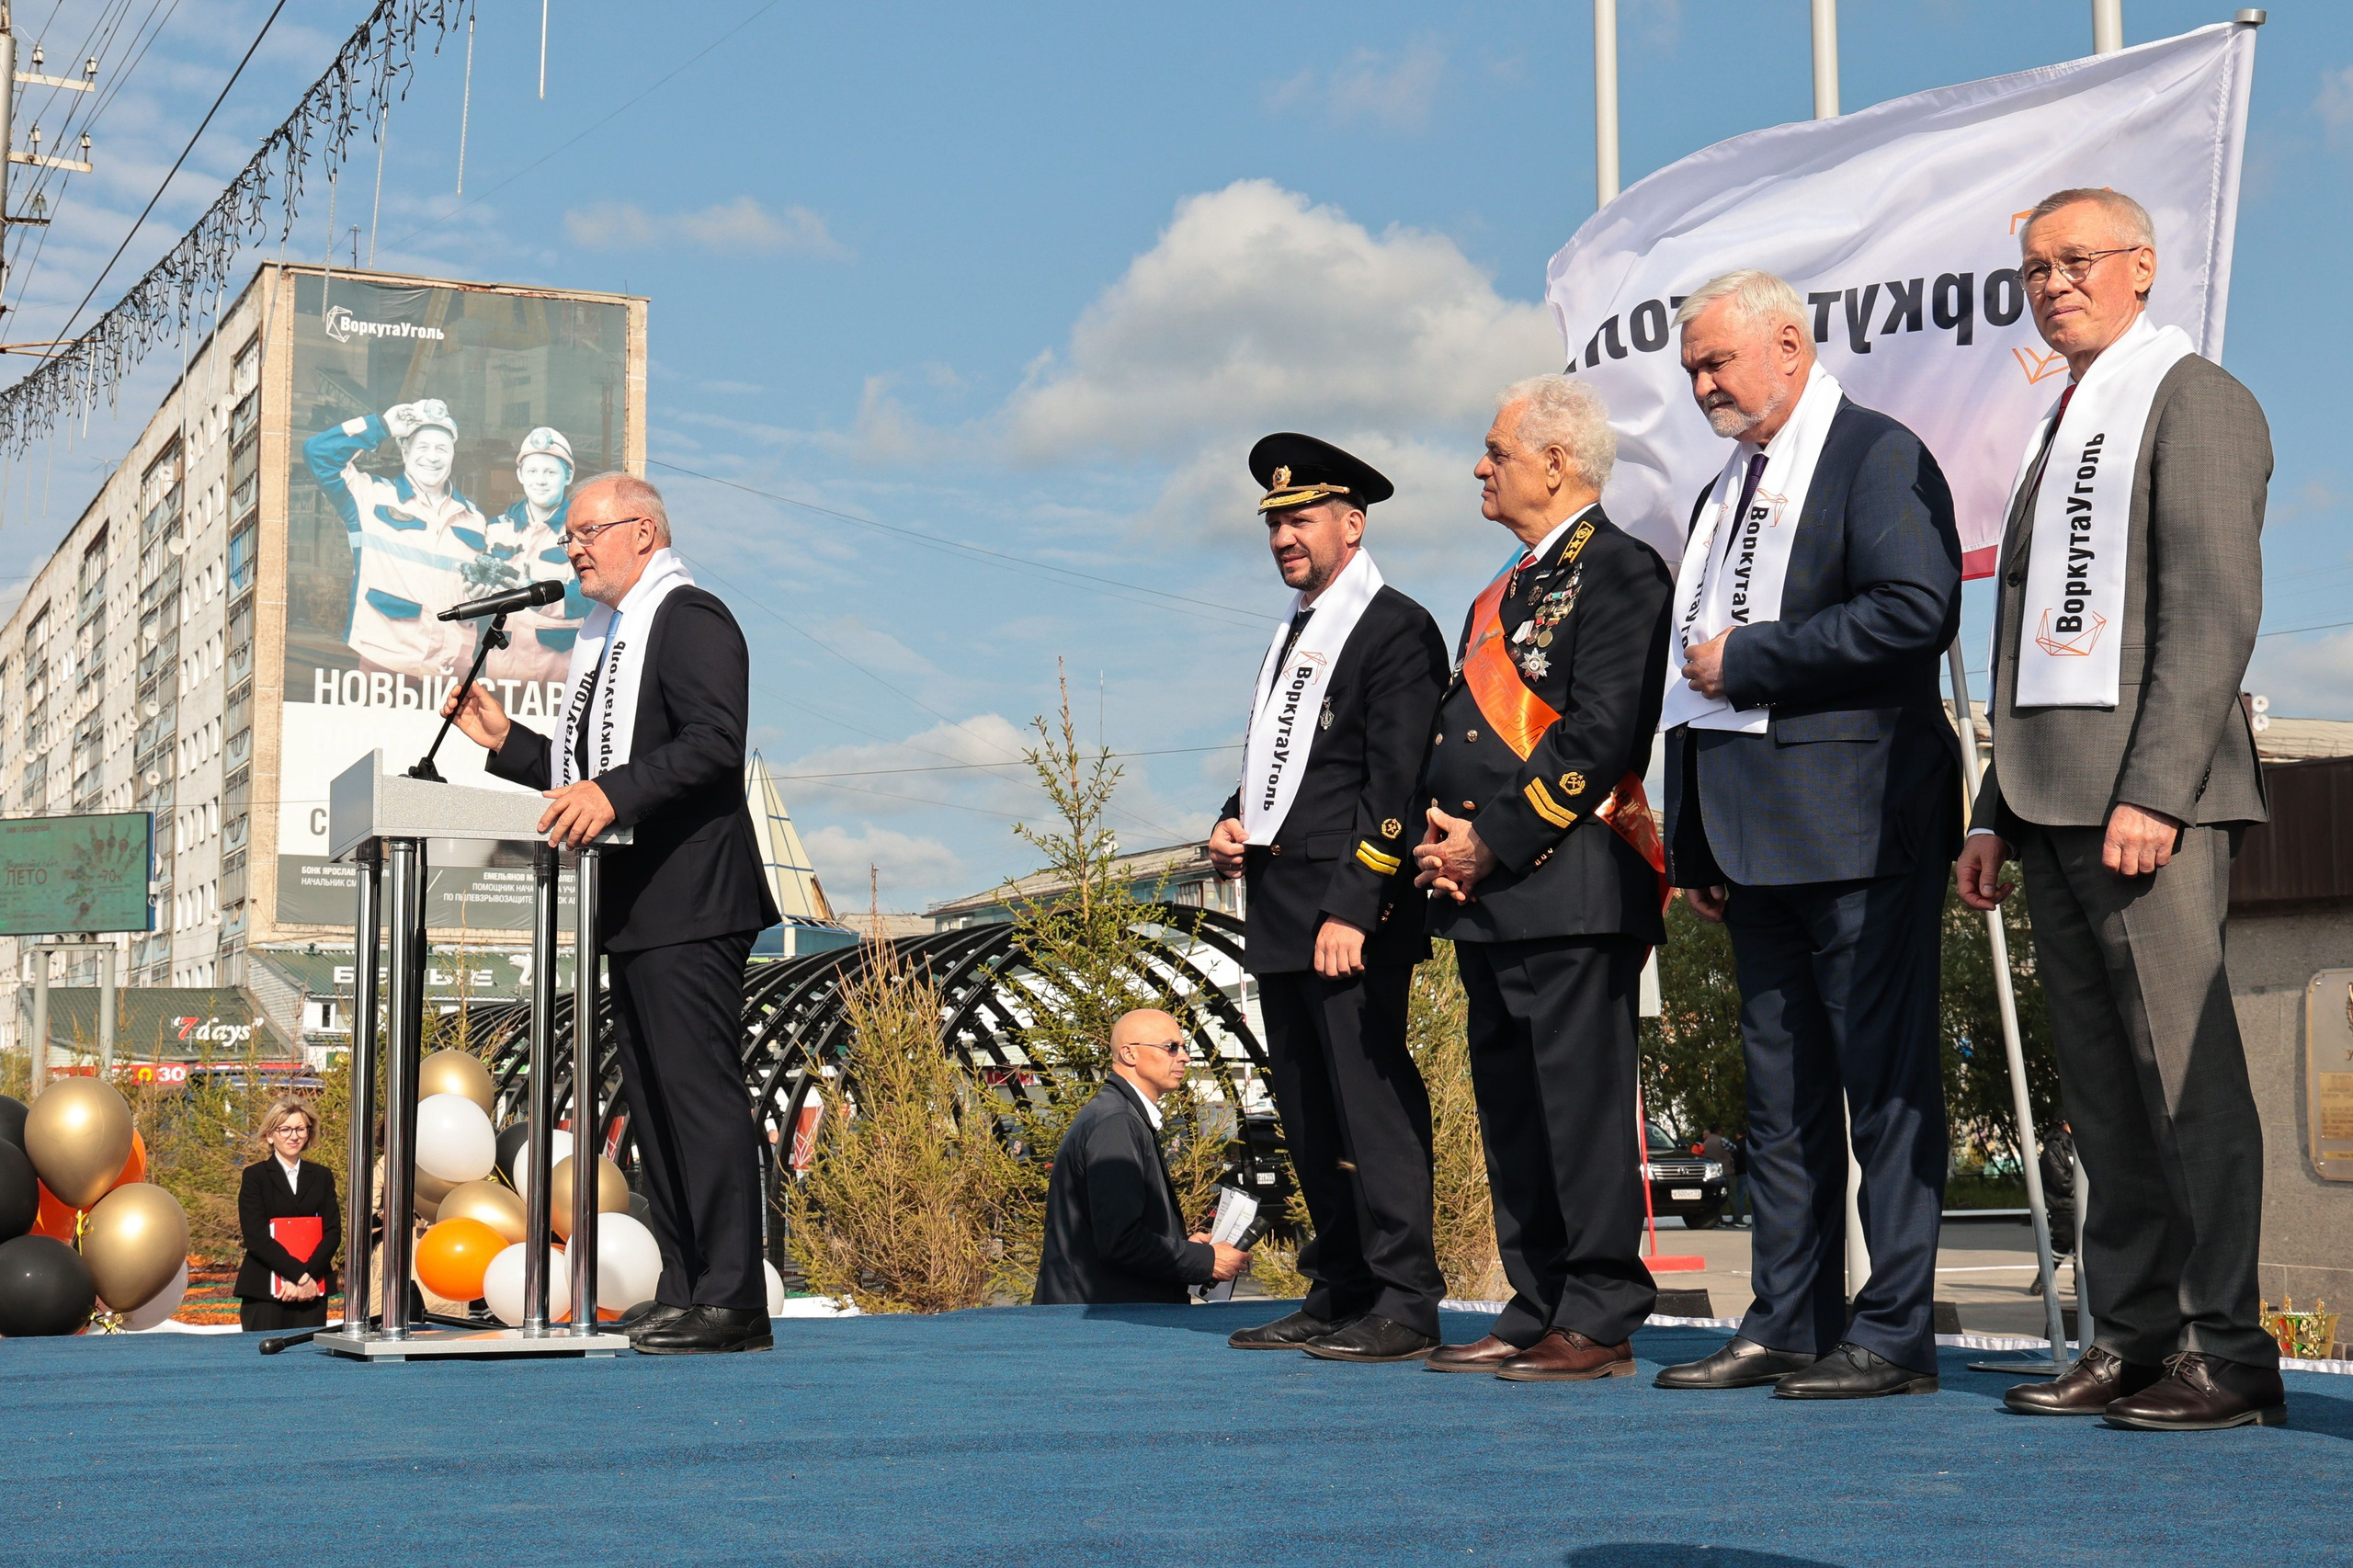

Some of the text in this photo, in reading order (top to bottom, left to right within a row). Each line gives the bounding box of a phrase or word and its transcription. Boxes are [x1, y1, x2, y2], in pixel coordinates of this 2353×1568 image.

[340, 316, 445, 340] ВоркутаУголь
[2055, 432, 2106, 633] ВоркутаУголь
[1465, 647, 1547, 761] ВЕТЕРА
[1263, 666, 1313, 812] ВоркутаУголь
[6, 868, 47, 886] ЛЕТО
[301, 866, 321, 875] БОНК
[483, 871, 525, 881] ЕМЕЛЬЯНОВ
[301, 877, 345, 887] НАЧАЛЬНИК
[472, 882, 515, 892] ПОМОЩНИК
[444, 892, 454, 901] ПО
